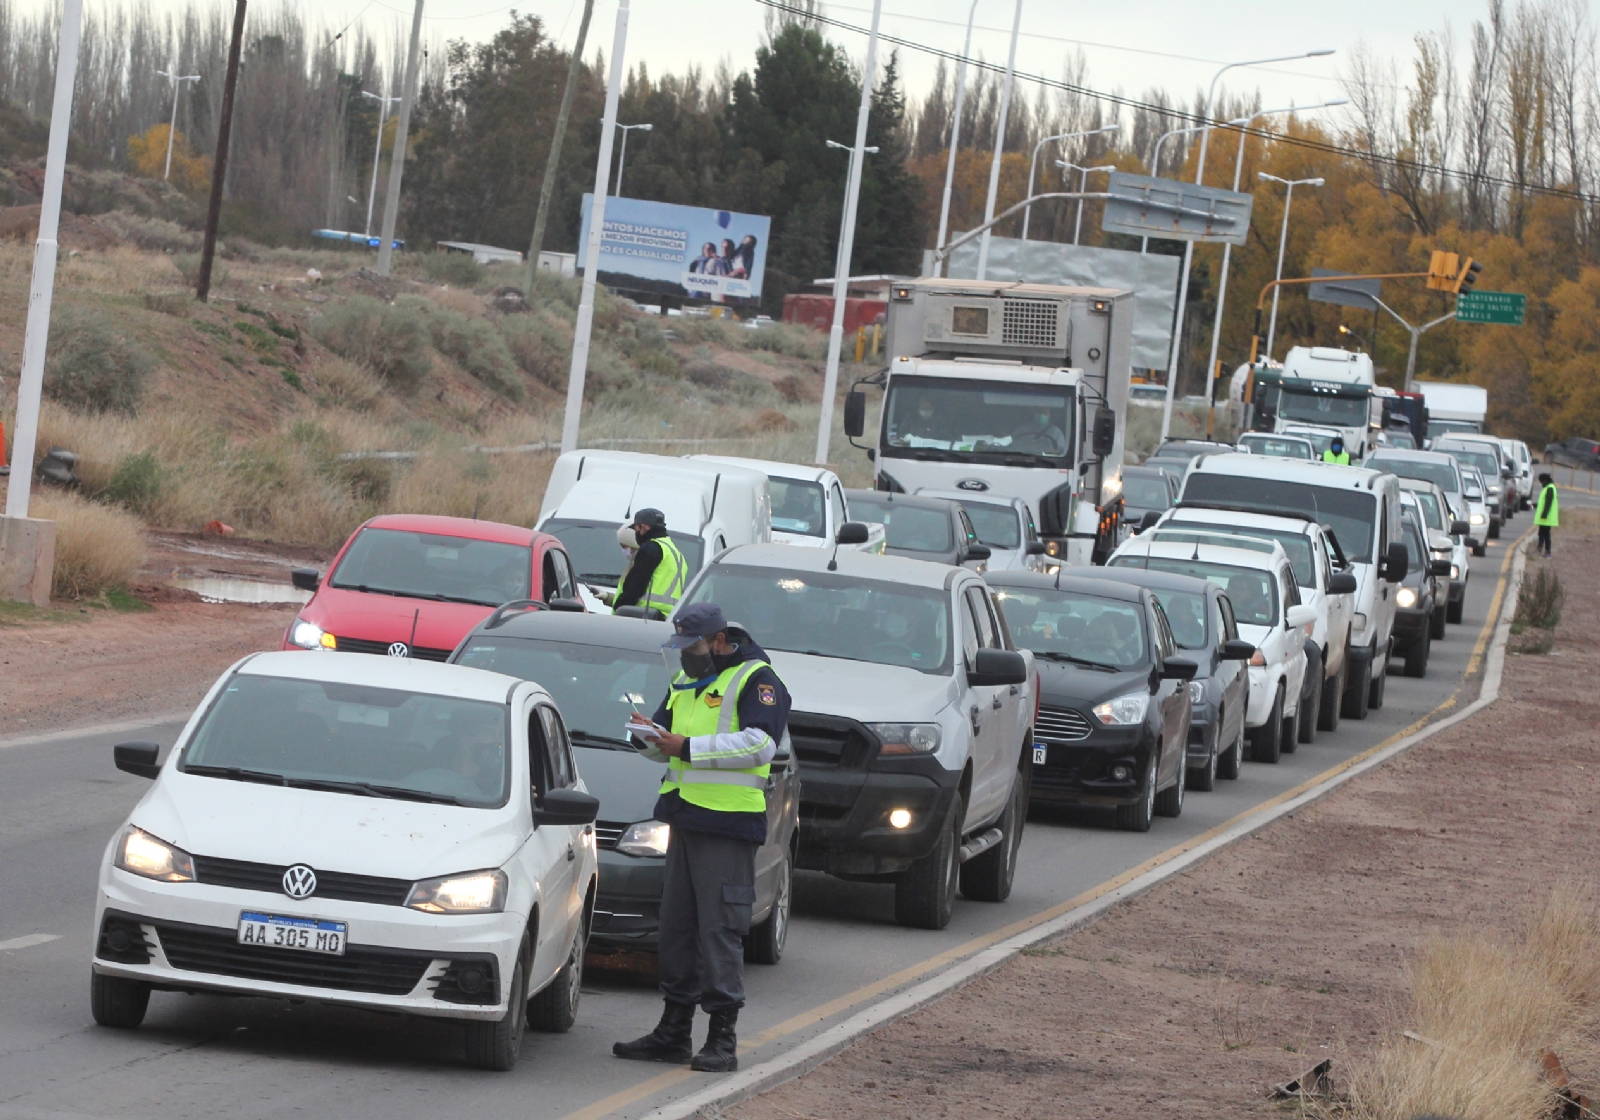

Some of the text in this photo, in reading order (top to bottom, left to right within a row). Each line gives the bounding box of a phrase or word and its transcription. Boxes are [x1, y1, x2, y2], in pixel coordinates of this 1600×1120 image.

[603, 221, 687, 239] NTOS HACEMOS
[605, 232, 635, 242] MEJOR
[636, 236, 683, 249] PROVINCIA
[625, 248, 684, 262] CASUALIDAD
[244, 923, 266, 944] AA
[273, 926, 309, 948] 305
